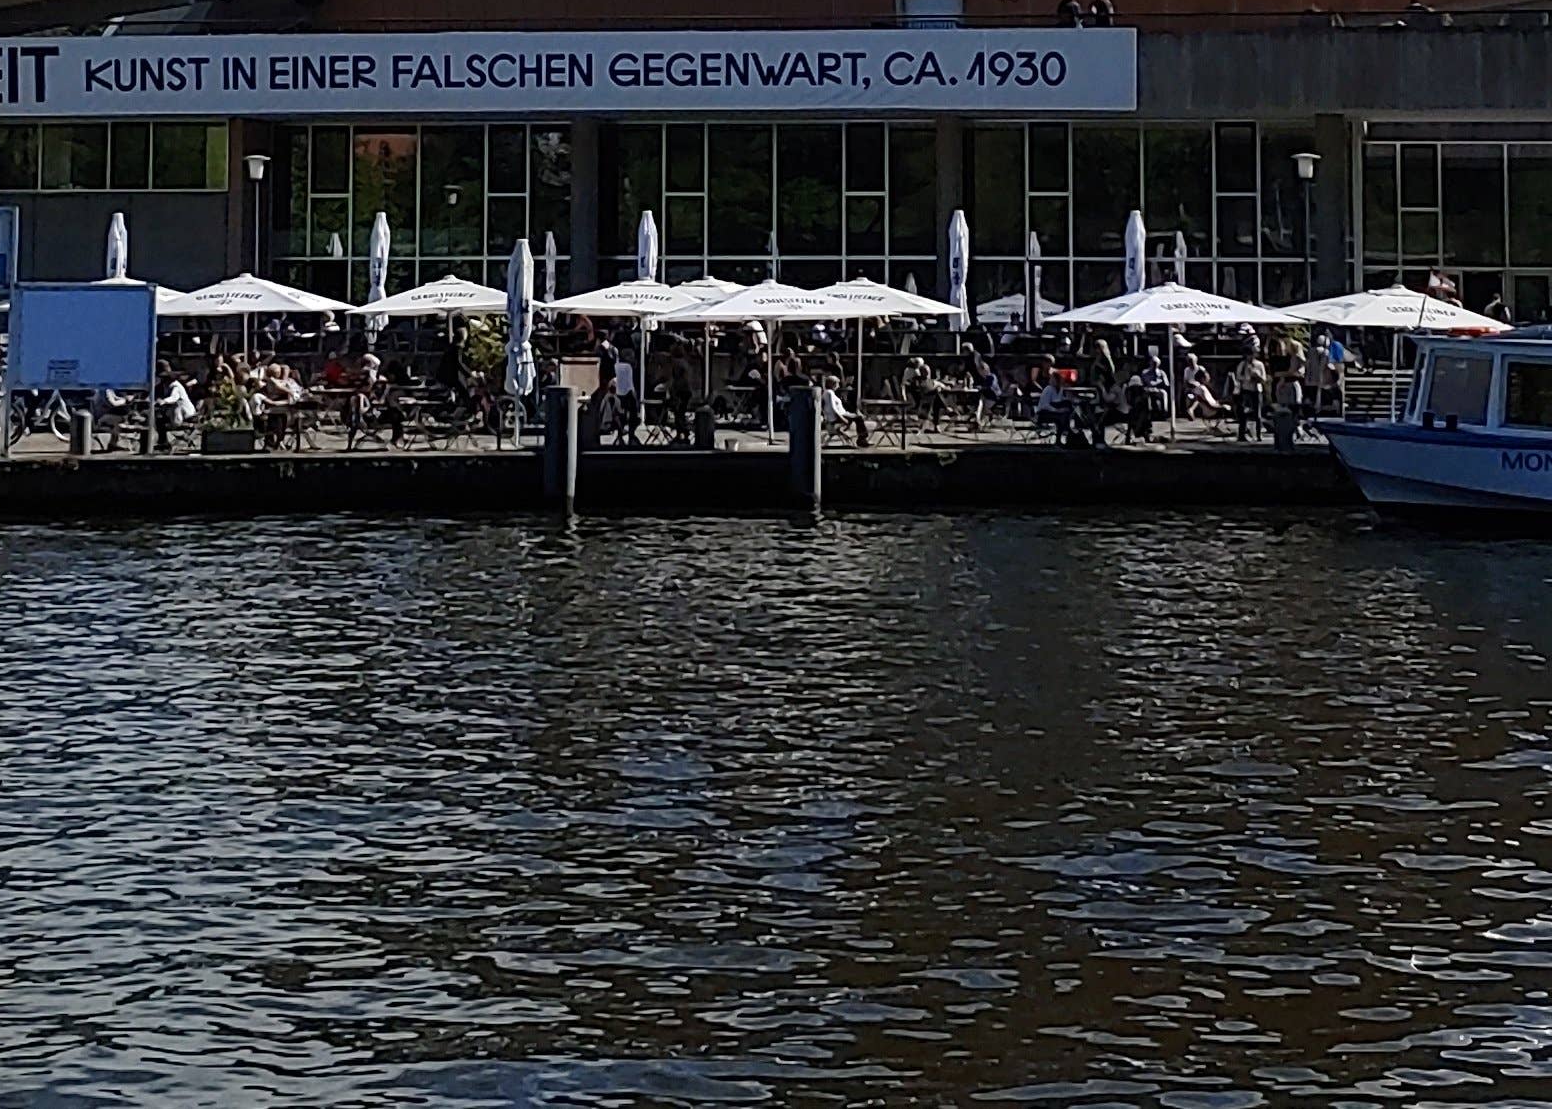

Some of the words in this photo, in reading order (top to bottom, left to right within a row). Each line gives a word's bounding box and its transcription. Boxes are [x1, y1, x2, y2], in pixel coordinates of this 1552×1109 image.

[86, 58, 210, 91] KUNST
[223, 57, 257, 90] IN
[270, 56, 377, 89] EINER
[393, 54, 593, 88] FALSCHEN
[609, 52, 871, 89] GEGENWART,
[884, 52, 958, 86] CA.
[967, 51, 1067, 86] 1930
